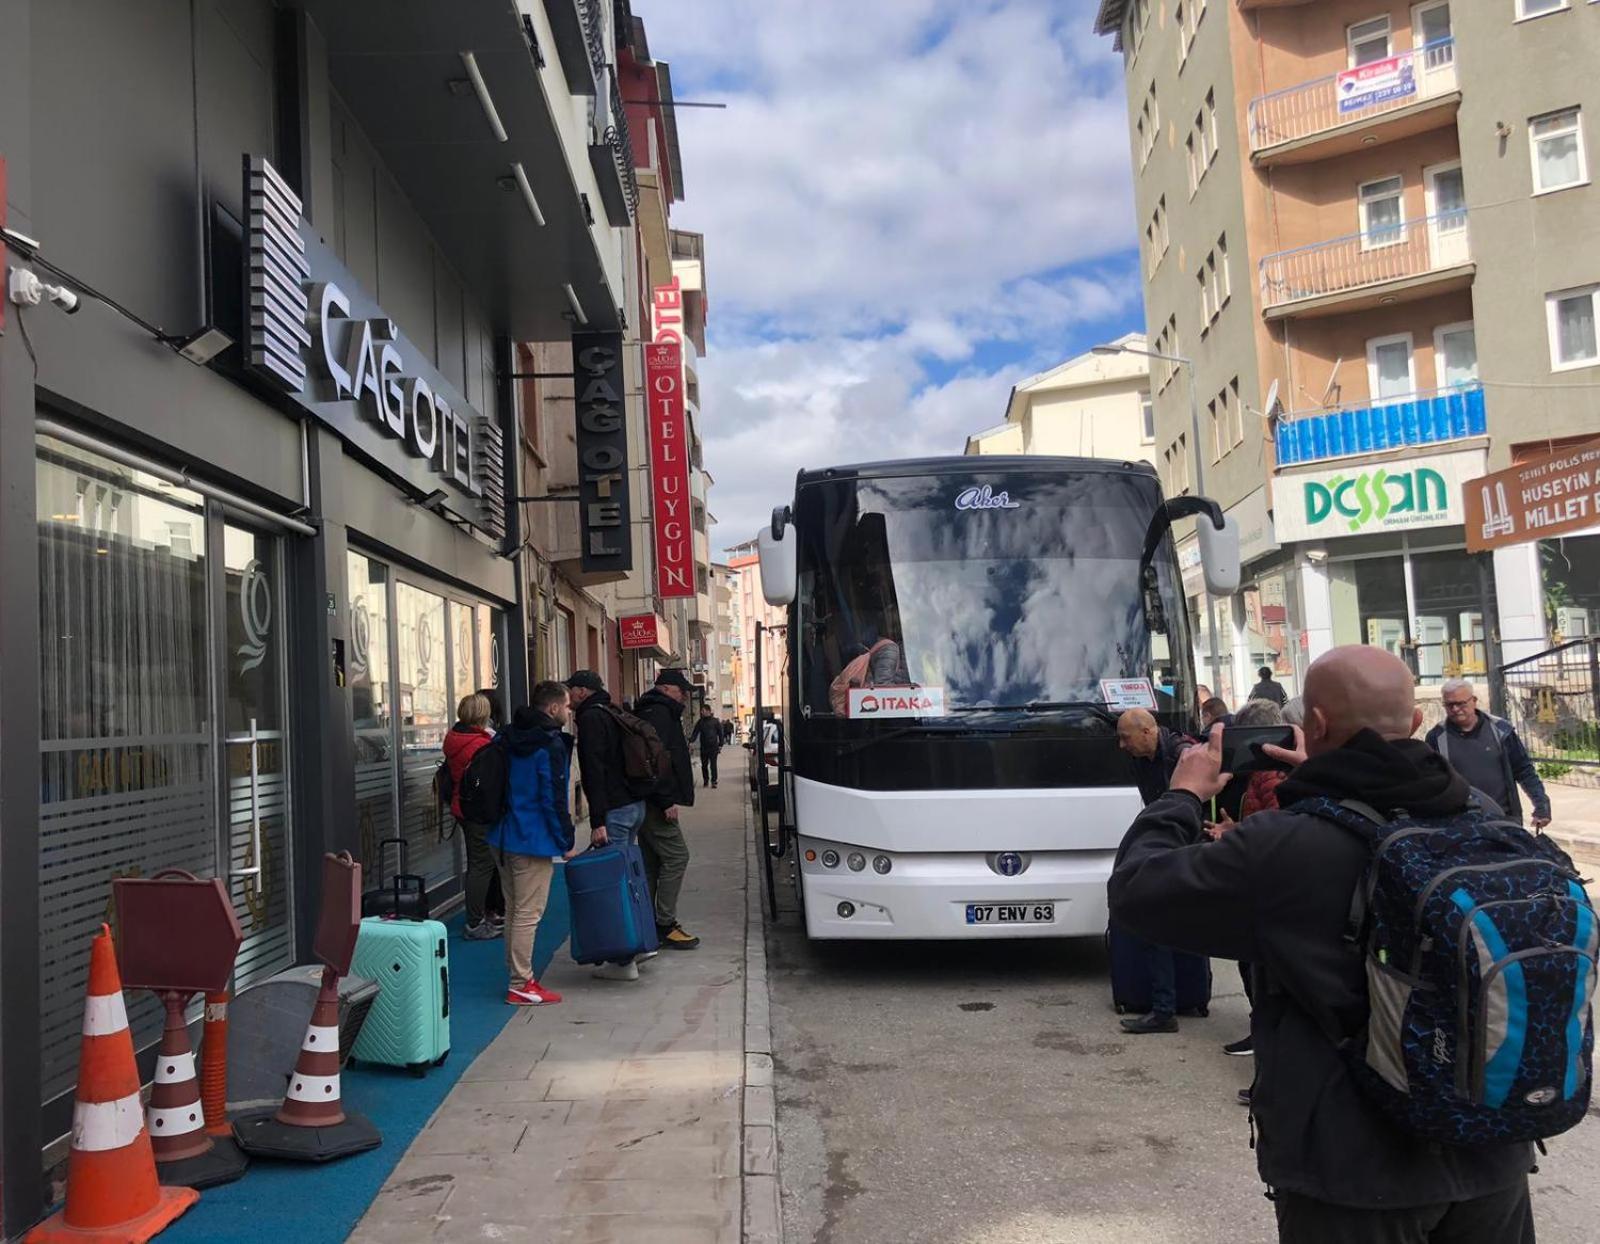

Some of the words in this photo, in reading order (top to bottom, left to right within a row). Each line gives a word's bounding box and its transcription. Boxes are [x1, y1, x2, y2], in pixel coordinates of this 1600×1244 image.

[413, 376, 483, 498] OTEL
[654, 375, 677, 462] OTEL
[582, 445, 624, 556] OTEL
[662, 476, 691, 588] UYGUN
[881, 696, 933, 711] ITAKA
[974, 907, 994, 922] 07
[998, 906, 1028, 921] ENV
[1033, 906, 1053, 921] 63
